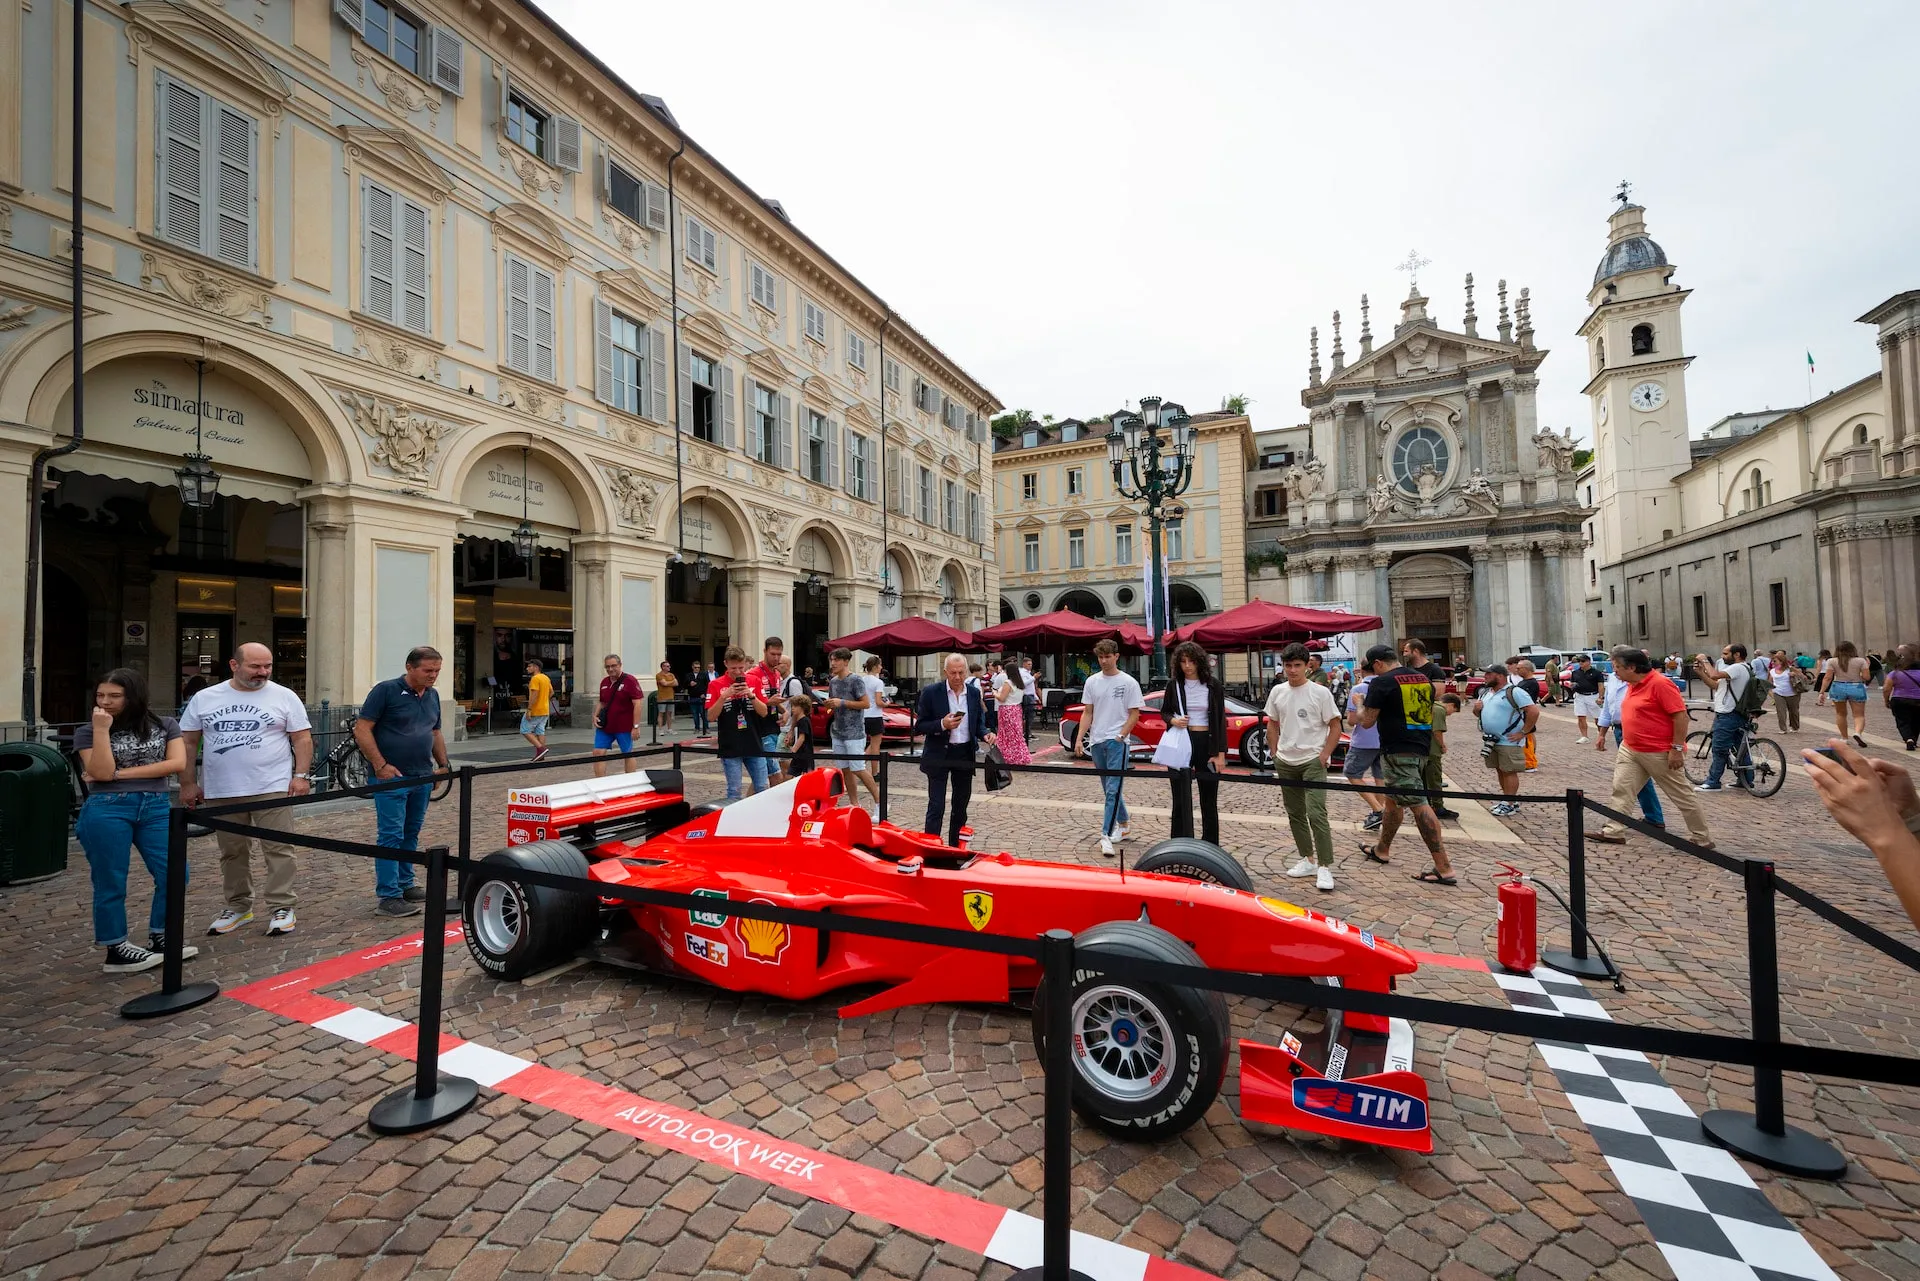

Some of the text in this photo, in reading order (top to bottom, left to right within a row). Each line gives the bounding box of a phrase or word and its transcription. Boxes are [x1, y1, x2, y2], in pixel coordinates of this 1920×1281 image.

[134, 388, 245, 426] sinatra
[133, 416, 183, 433] Galerie
[1327, 635, 1350, 653] EK
[203, 704, 262, 729] UNIVERSITY
[218, 721, 256, 731] US-37
[519, 793, 549, 805] Shell
[1149, 863, 1224, 888] RIDGESTON
[686, 934, 726, 965] FedEx
[1073, 1033, 1087, 1058] BBS
[1150, 1063, 1168, 1087] BBS
[1391, 1056, 1408, 1072] ell
[1133, 1033, 1201, 1128] POTENZA
[1357, 1091, 1412, 1124] TIM
[615, 1105, 824, 1181] AUTOLOOK WEEK
